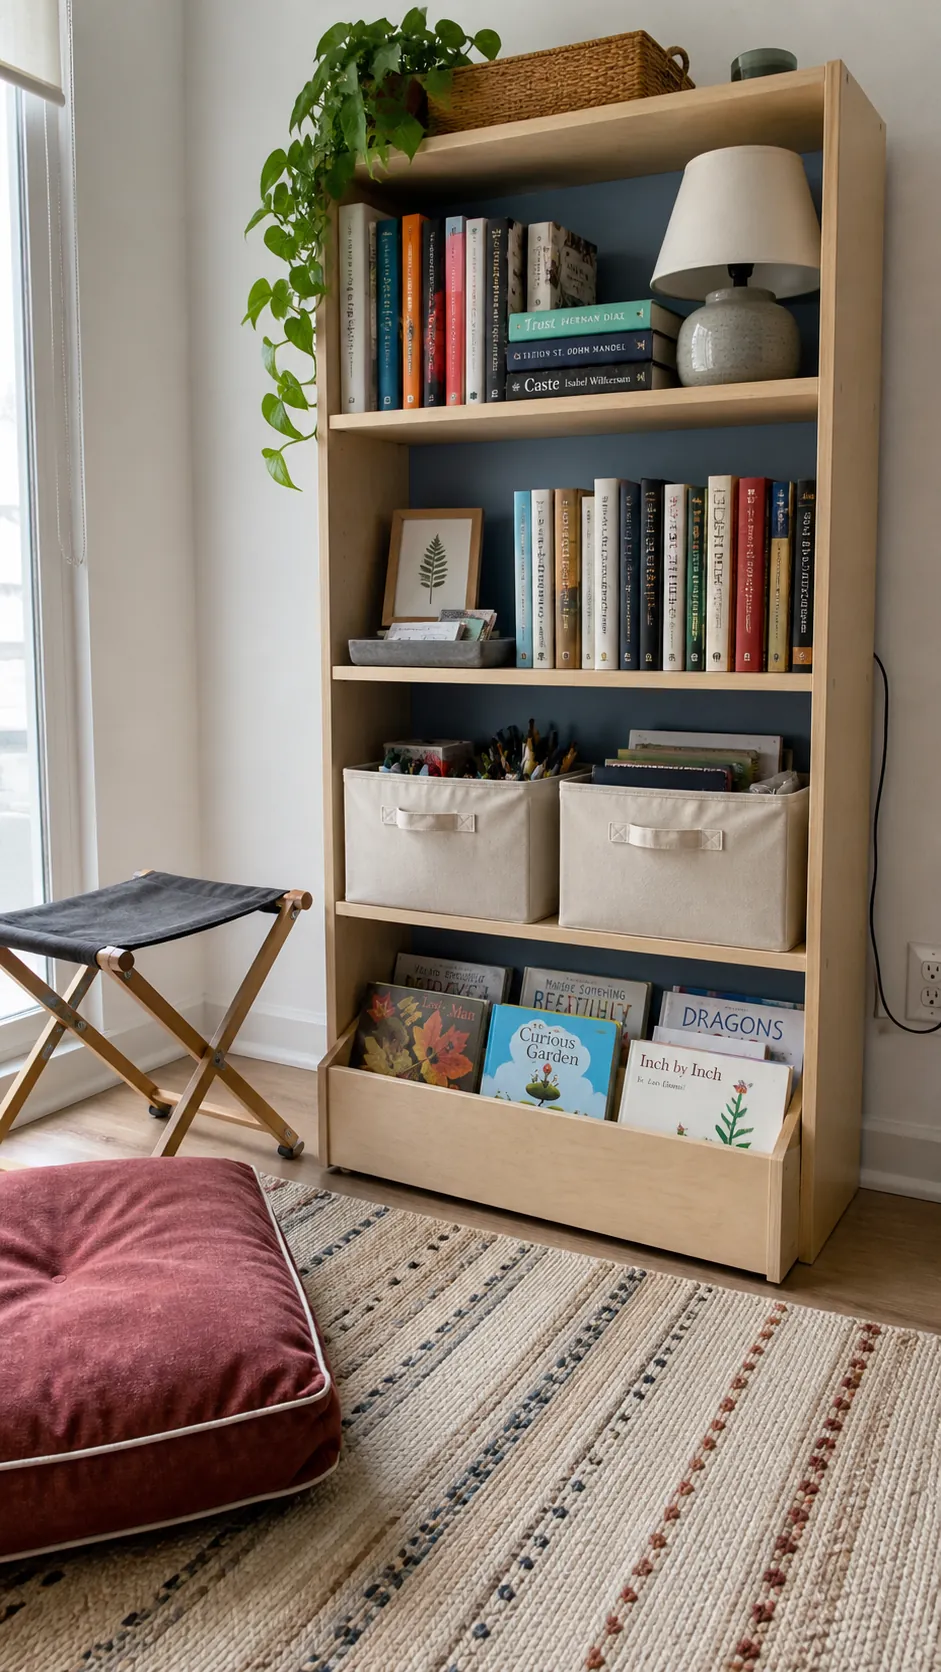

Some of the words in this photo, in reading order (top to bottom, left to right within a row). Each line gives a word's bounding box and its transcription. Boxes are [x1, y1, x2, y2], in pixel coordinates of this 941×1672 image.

[524, 377, 560, 393] Caste
[564, 376, 588, 388] Isabel
[448, 1003, 476, 1021] Man
[682, 1006, 784, 1041] DRAGONS
[519, 1026, 576, 1050] Curious
[526, 1044, 579, 1066] Garden
[639, 1053, 670, 1072] Inch
[673, 1059, 689, 1078] by
[690, 1062, 723, 1082] Inch
